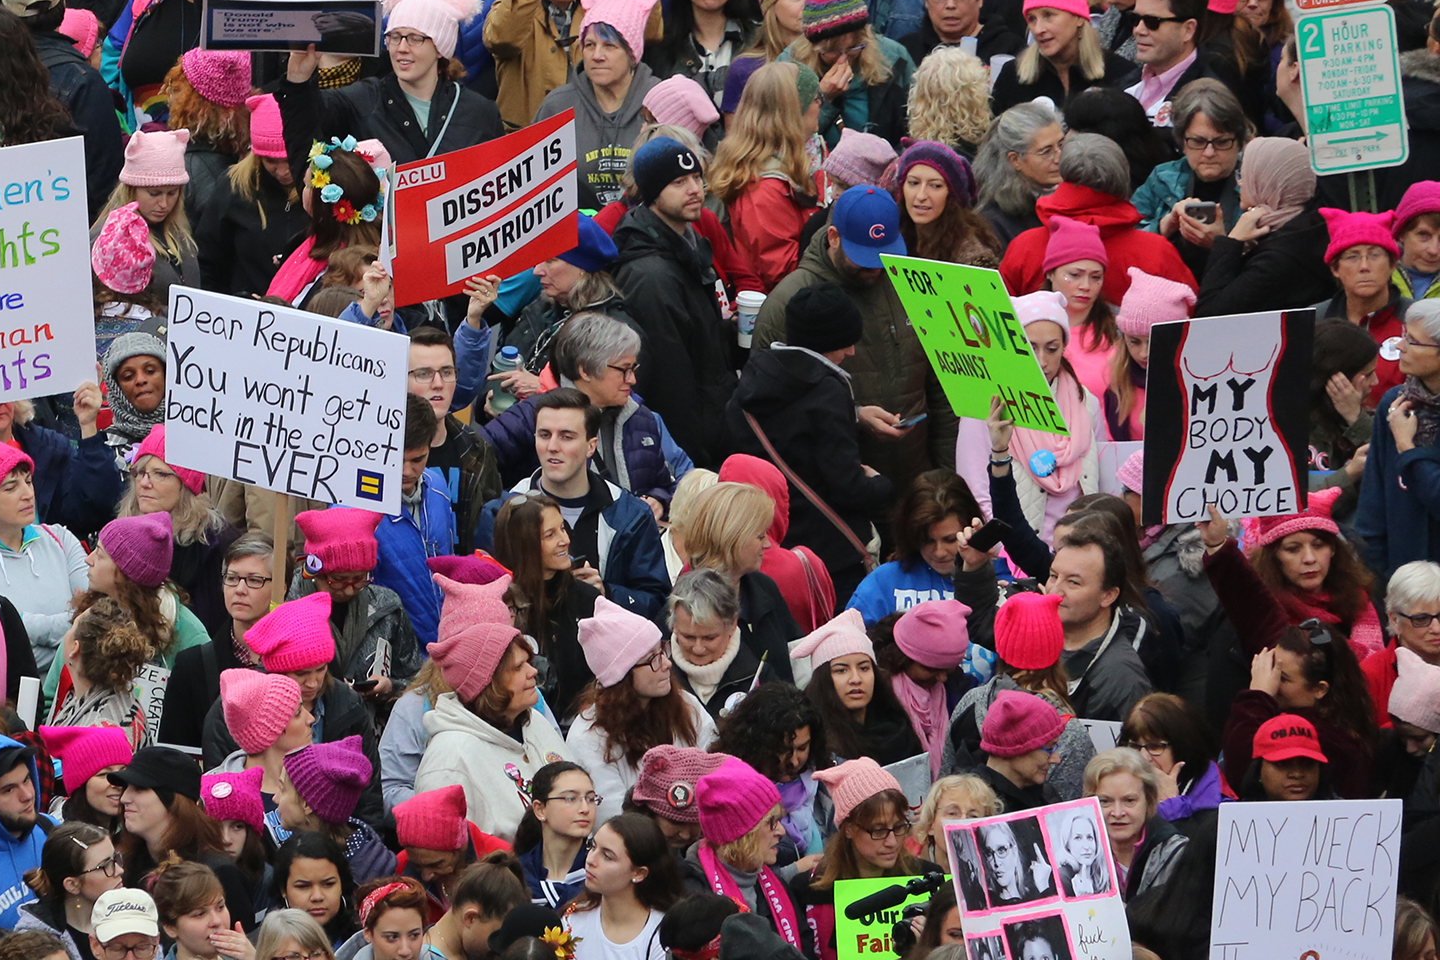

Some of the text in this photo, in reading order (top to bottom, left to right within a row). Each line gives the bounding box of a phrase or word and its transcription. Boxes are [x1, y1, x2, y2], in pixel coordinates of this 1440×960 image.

[1302, 23, 1369, 53] 2 HOUR
[1333, 39, 1383, 55] PARKING
[1332, 87, 1371, 100] SATURDAY
[397, 164, 442, 188] ACLU
[442, 137, 562, 227] DISSENT IS
[461, 186, 564, 269] PATRIOTIC
[903, 268, 938, 296] FOR
[172, 294, 387, 379] Dear Republicans,
[946, 300, 1029, 357] LOVE
[169, 341, 371, 426] You won't get
[935, 349, 992, 381] AGAINST
[997, 384, 1067, 432] HATE
[1191, 377, 1256, 416] MY
[167, 390, 398, 467] back closet.
[1190, 416, 1268, 449] BODY
[232, 440, 343, 504] EVER.
[1204, 445, 1274, 485] MY
[1176, 487, 1291, 519] CHOICE
[1225, 811, 1401, 877] MY NECK
[105, 901, 146, 917] Titleist
[1219, 871, 1390, 937] MY BACK
